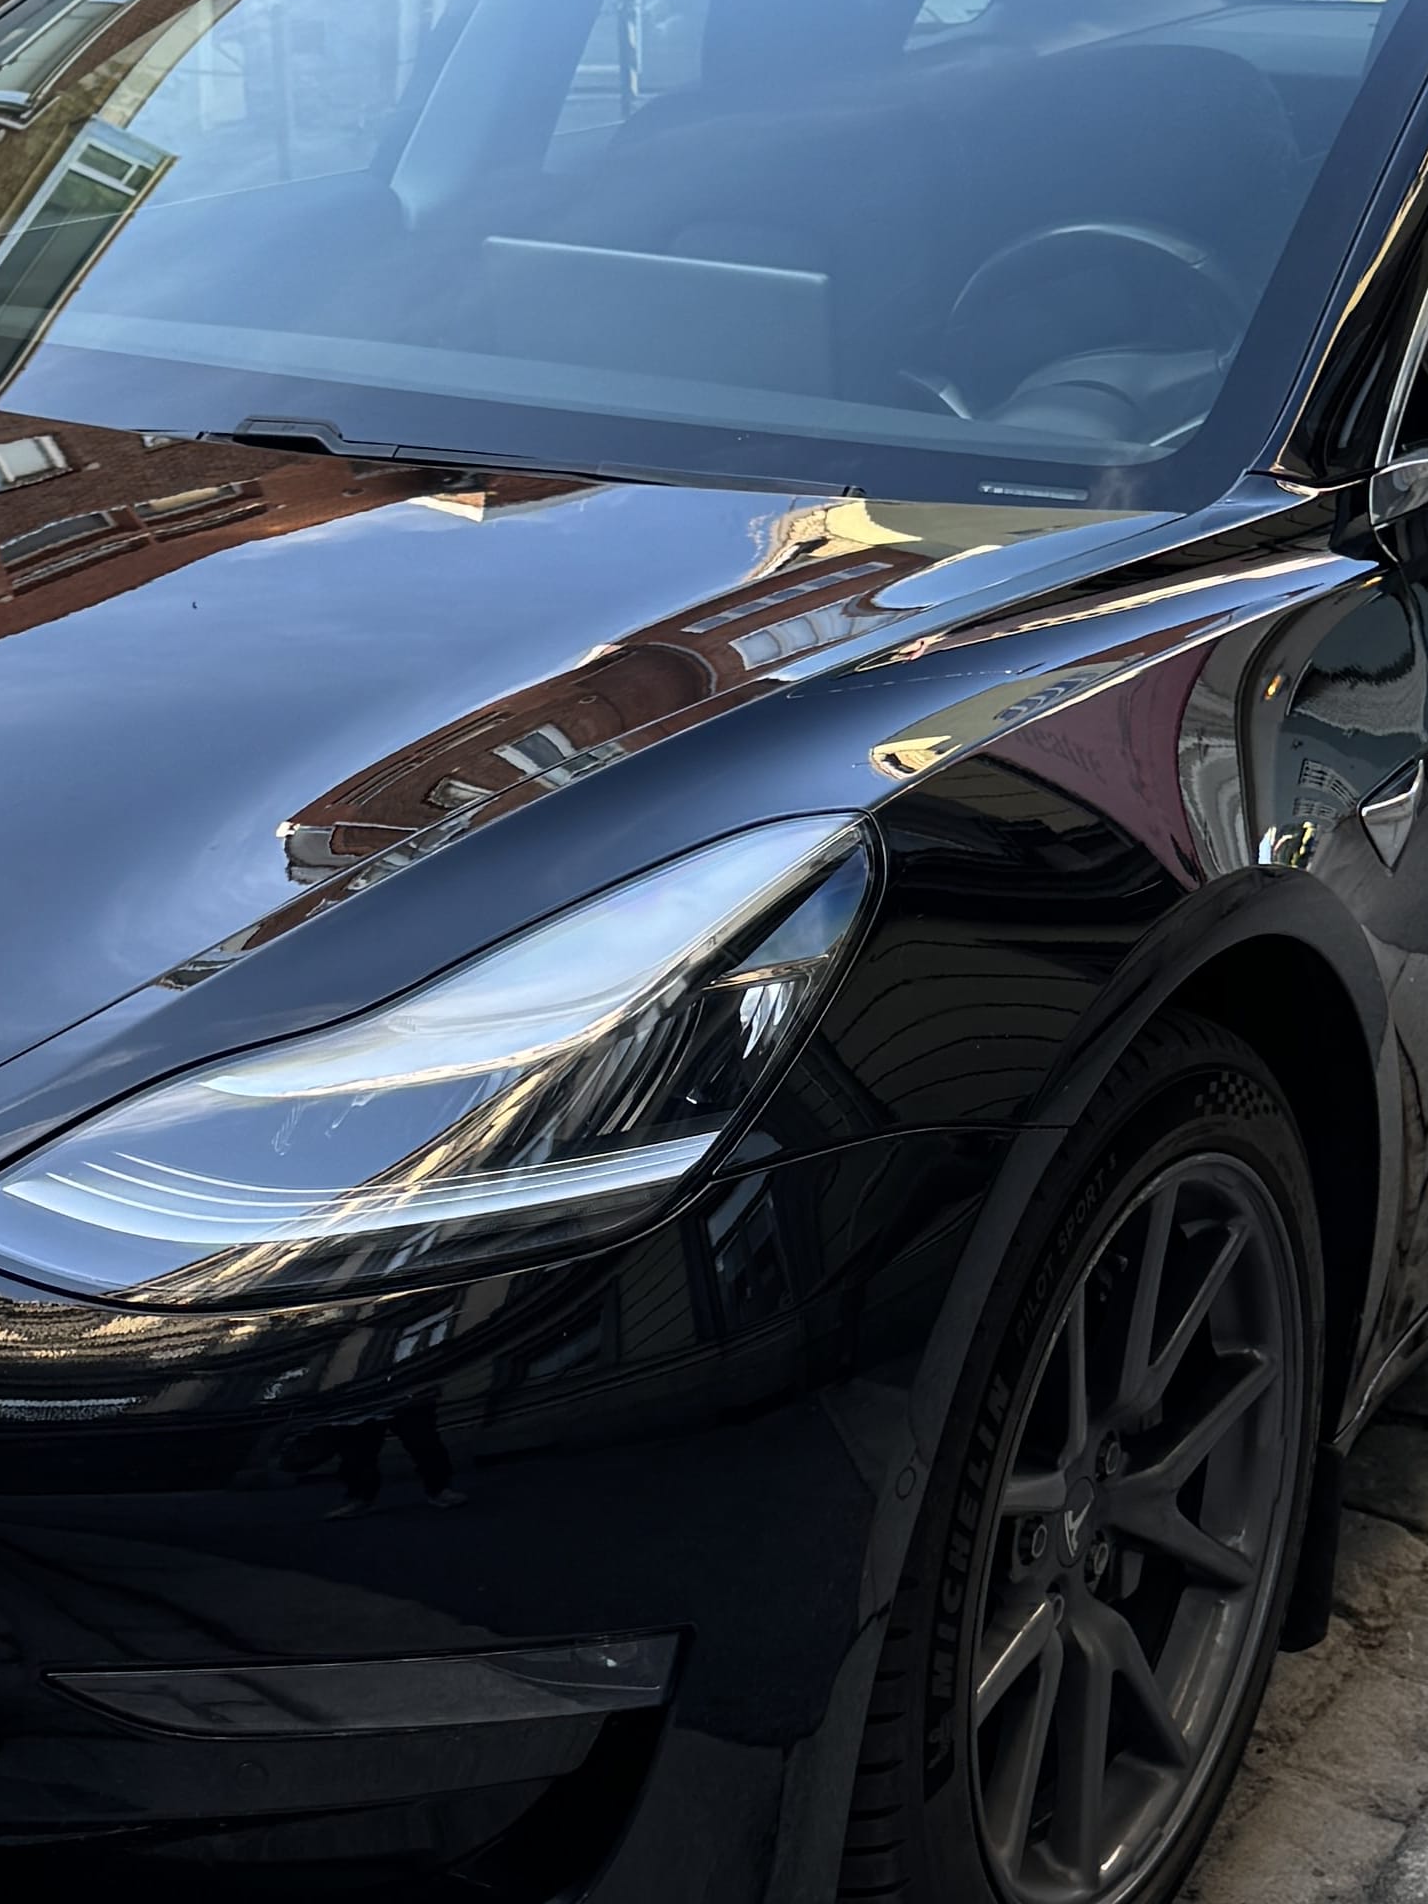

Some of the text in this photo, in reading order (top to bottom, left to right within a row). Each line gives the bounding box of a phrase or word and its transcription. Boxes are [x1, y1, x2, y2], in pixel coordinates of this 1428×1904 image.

[1014, 1252, 1057, 1348] PILOT
[1057, 1167, 1108, 1255] SPORT
[931, 1372, 1013, 1699] MICHELIN
